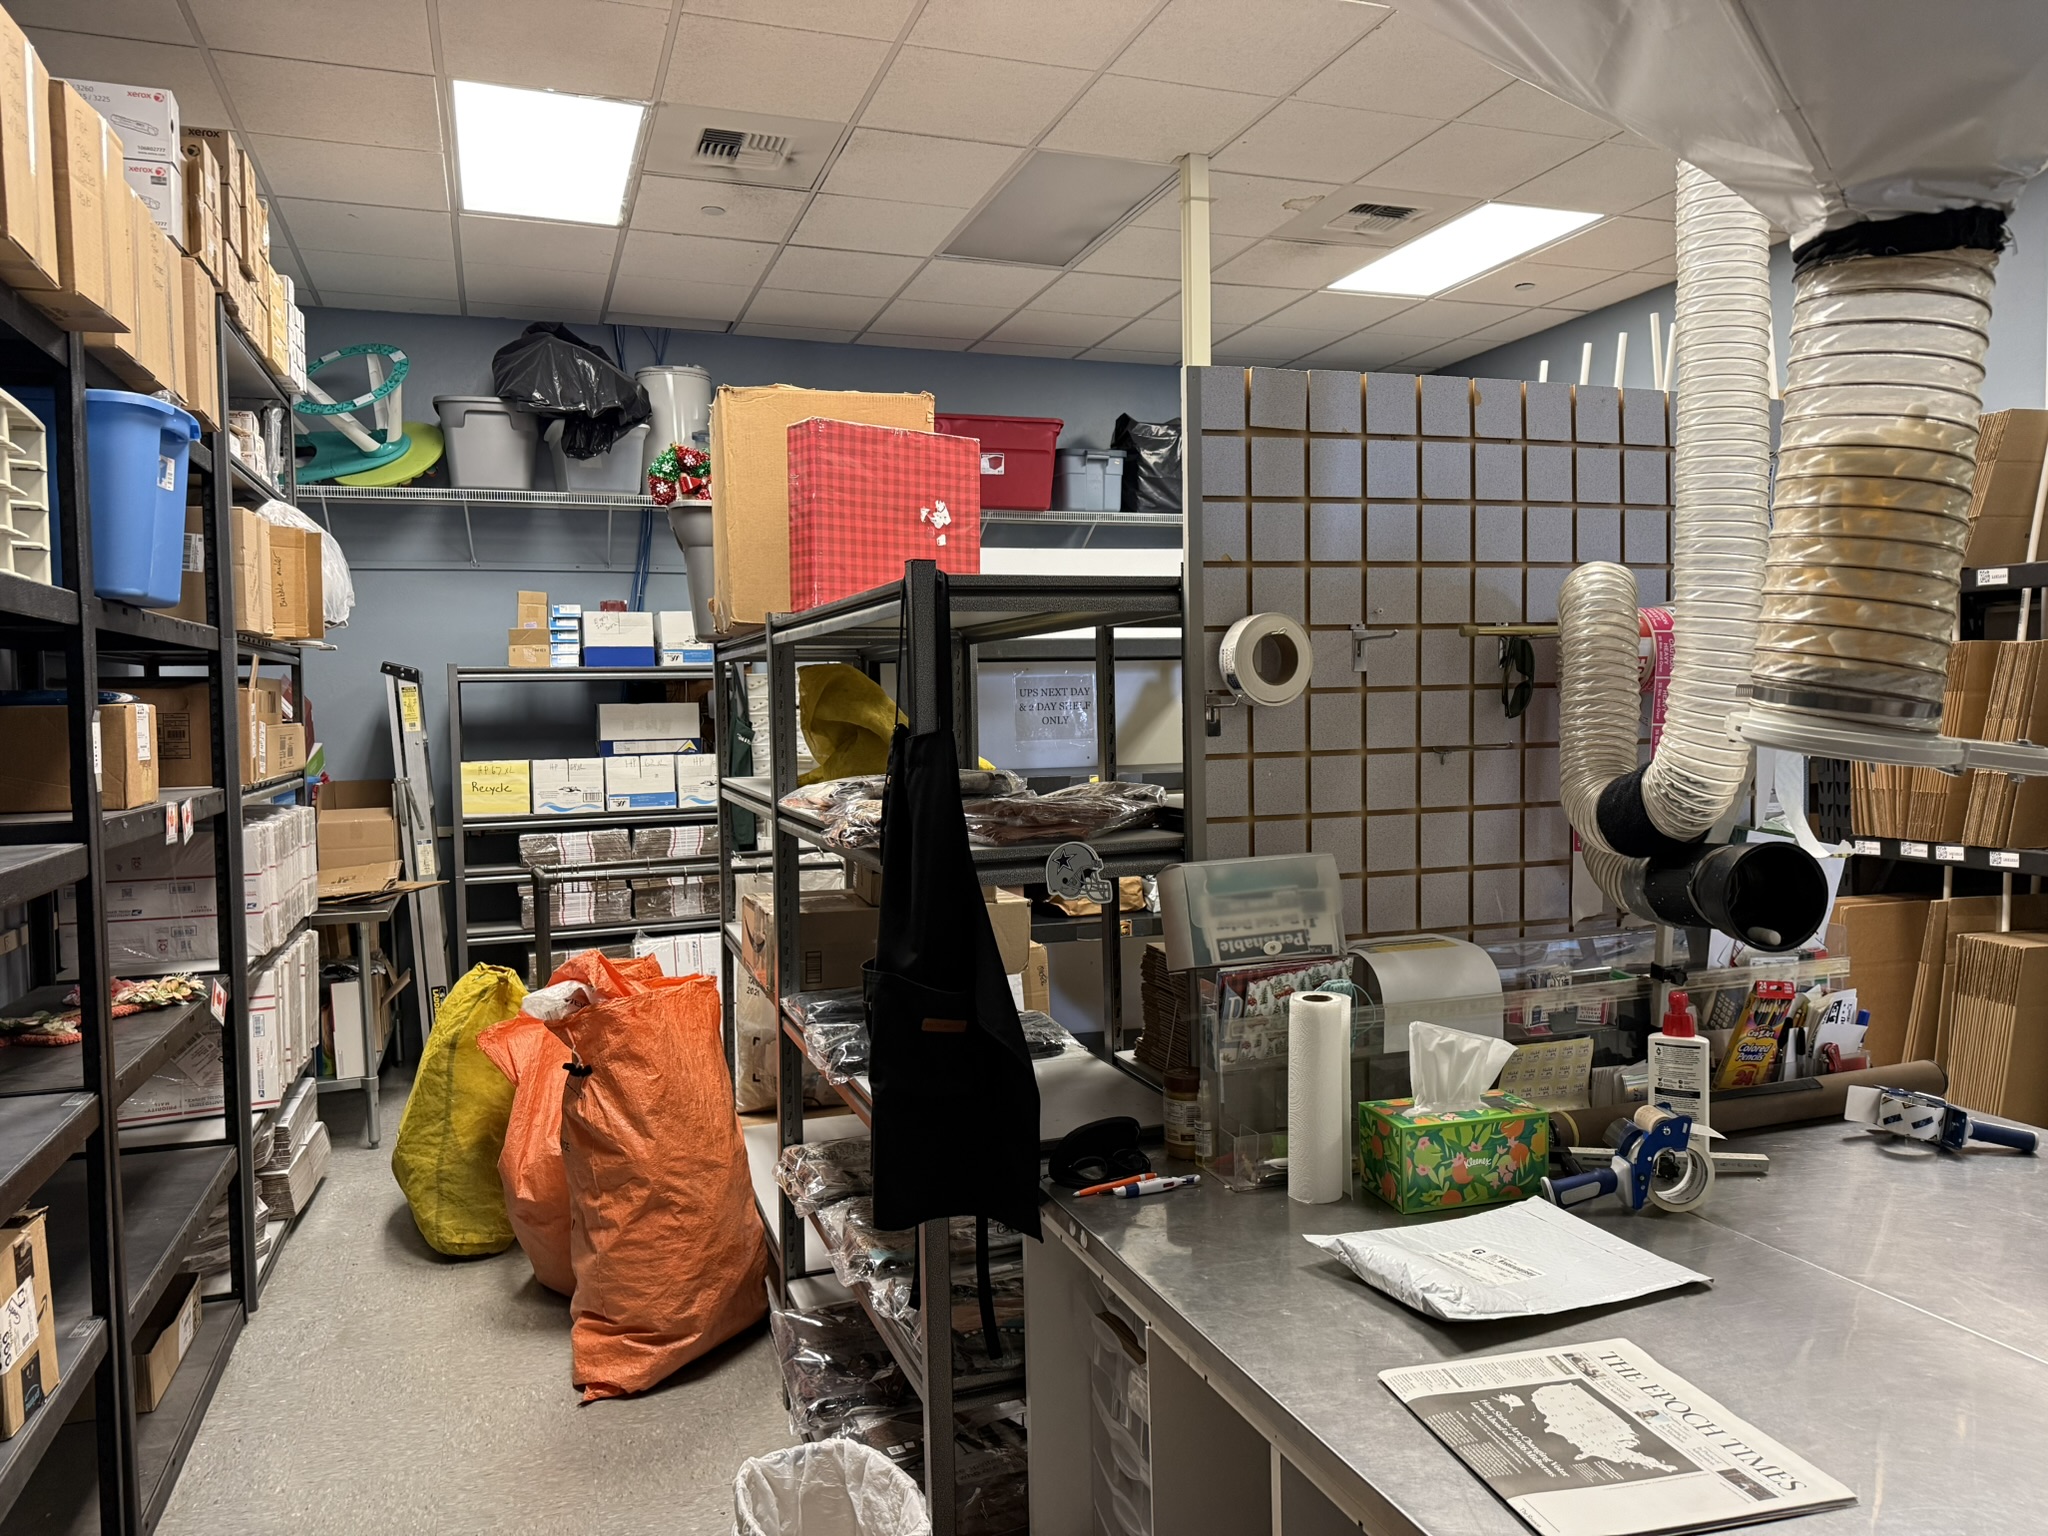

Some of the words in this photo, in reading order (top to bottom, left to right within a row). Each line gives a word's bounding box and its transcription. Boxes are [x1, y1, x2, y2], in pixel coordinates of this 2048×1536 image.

[76, 84, 94, 92] 3260
[94, 95, 111, 103] 3225
[127, 91, 151, 99] xerox
[188, 128, 220, 138] xerox
[128, 166, 153, 174] xerox
[1019, 688, 1038, 697] UPS
[1041, 688, 1068, 697] NEXT
[1070, 687, 1090, 696] DAY
[1037, 702, 1057, 711] DAY
[1059, 701, 1091, 711] SHELF
[1042, 716, 1069, 725] ONLY
[471, 782, 512, 795] Recycle
[1738, 1043, 1772, 1054] Colored
[1736, 1052, 1765, 1062] Pencils
[1732, 1067, 1755, 1086] 24
[147, 1105, 177, 1113] PRIORITY
[1464, 1157, 1492, 1169] Kleenex
[1598, 1351, 1648, 1383] THE
[1639, 1383, 1727, 1437] EPOCH
[1720, 1437, 1808, 1491] TIMES
[1470, 1402, 1488, 1416] Laws
[1486, 1415, 1507, 1431] Ahead
[1524, 1449, 1556, 1477] Midterms
[1495, 1410, 1512, 1427] States
[1521, 1435, 1554, 1462] Changing
[1550, 1461, 1570, 1477] Voter
